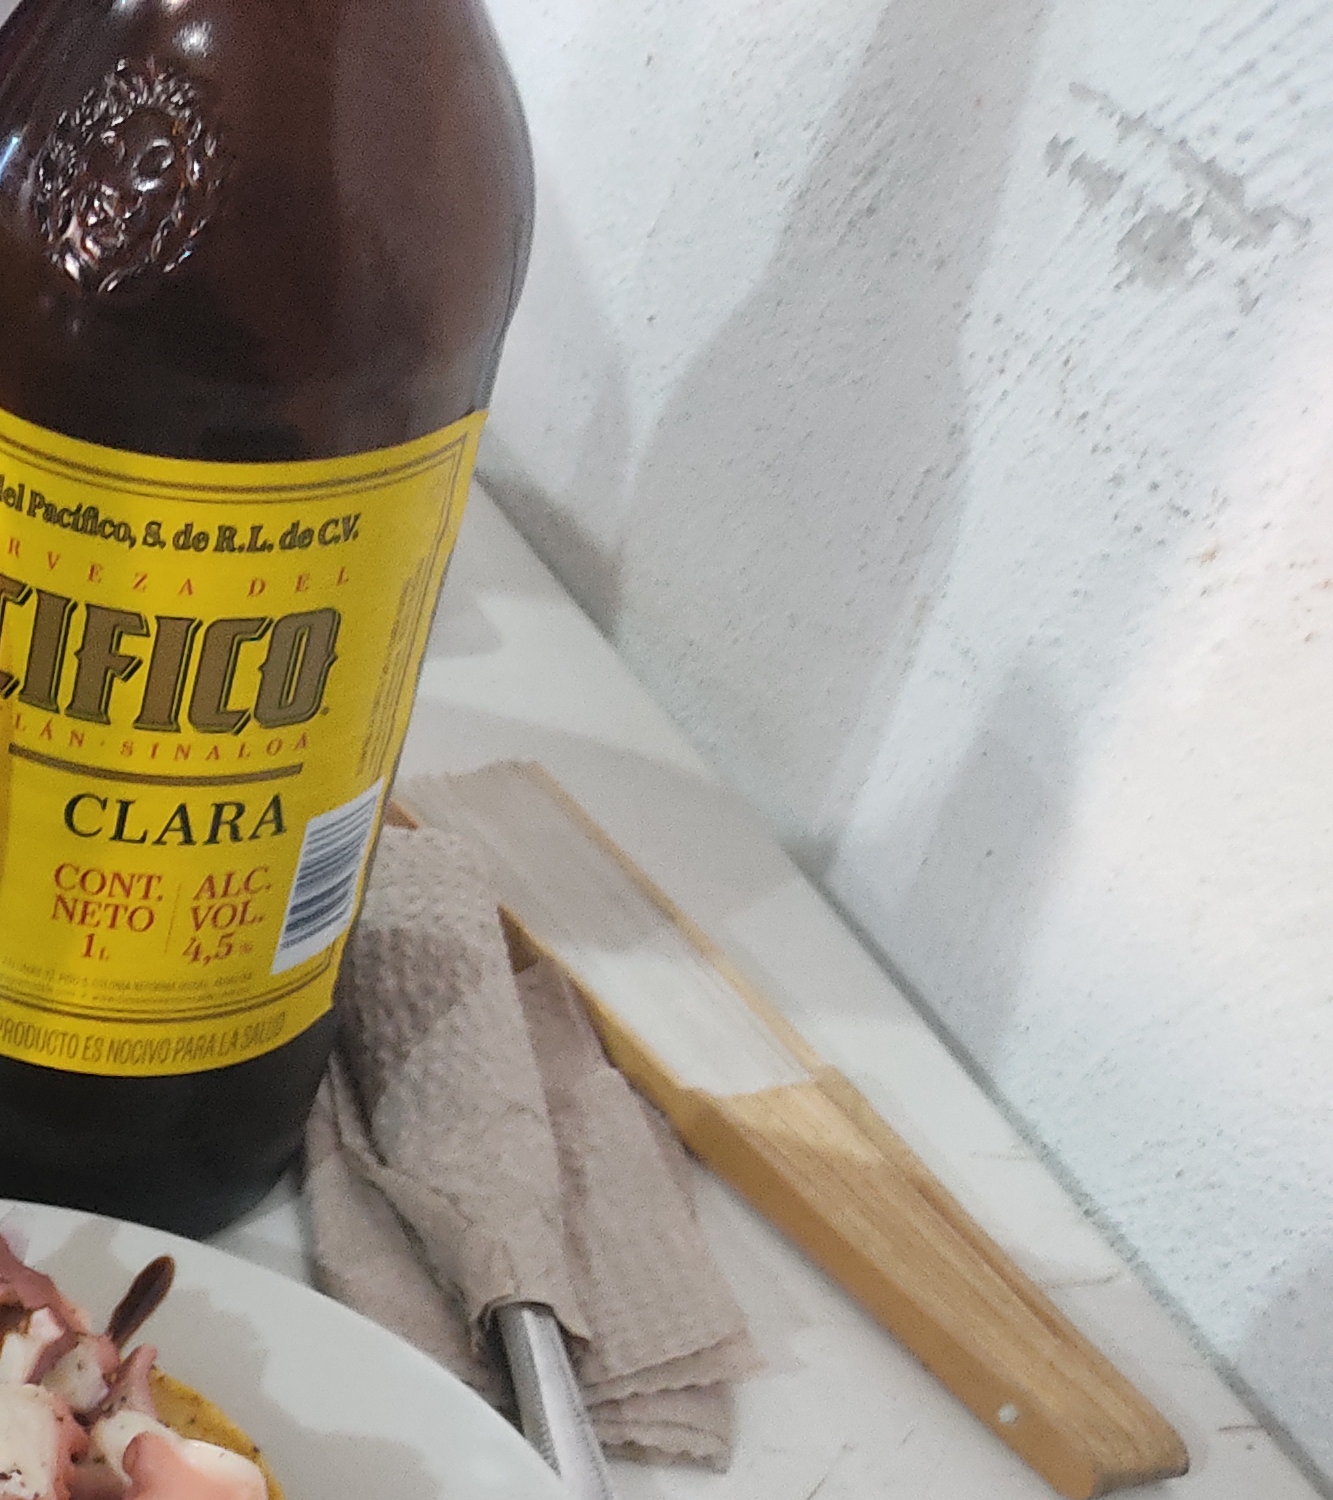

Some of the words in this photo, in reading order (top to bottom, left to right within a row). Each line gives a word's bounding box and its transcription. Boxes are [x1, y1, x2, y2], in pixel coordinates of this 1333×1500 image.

[142, 520, 166, 549] S.
[172, 521, 209, 552] de
[213, 524, 274, 553] R.L.
[279, 519, 314, 551] de
[318, 512, 362, 546] C.V.
[247, 566, 349, 598] DEL
[120, 732, 308, 761] SINALOA
[64, 791, 287, 846] CLARA
[54, 863, 163, 903] CONT.
[193, 865, 272, 901] ALC.
[52, 893, 155, 933] NETO
[190, 900, 264, 933] VOL.
[82, 1031, 104, 1064] ES
[106, 1034, 170, 1064] NOCIVO
[172, 1031, 214, 1061] PARA
[218, 1026, 240, 1057] LA
